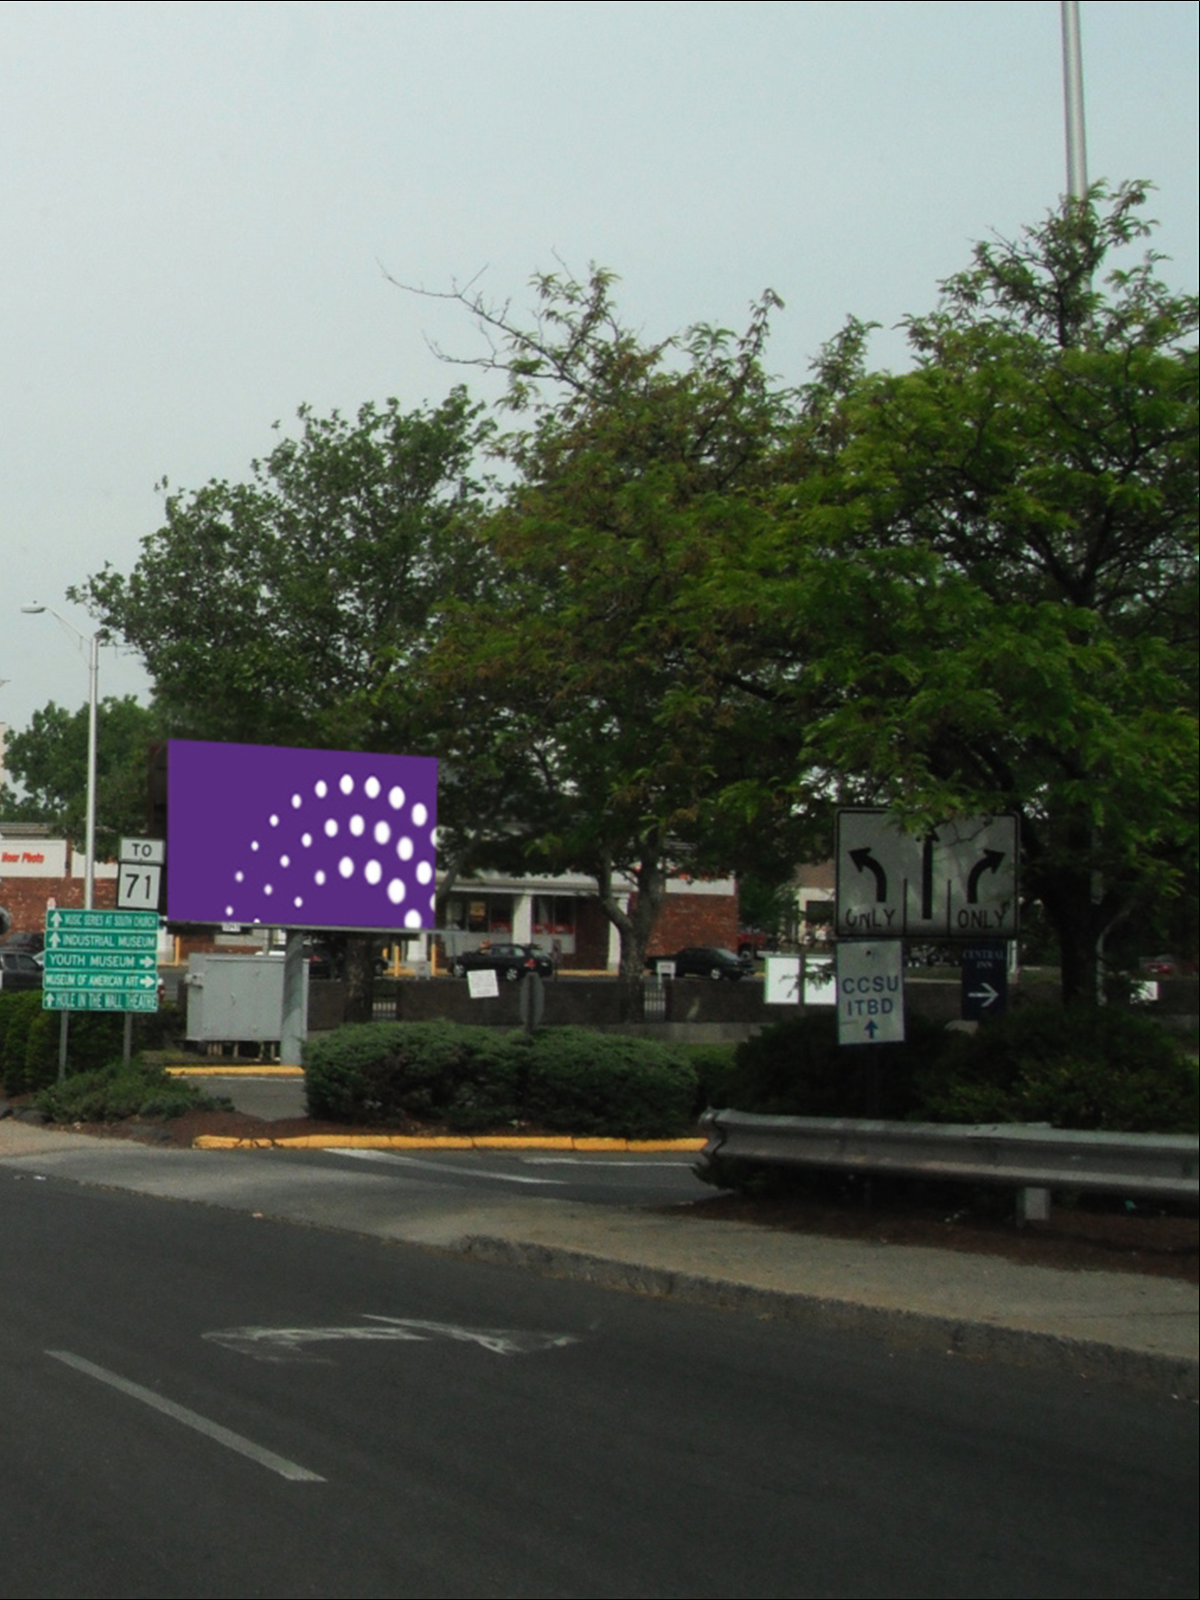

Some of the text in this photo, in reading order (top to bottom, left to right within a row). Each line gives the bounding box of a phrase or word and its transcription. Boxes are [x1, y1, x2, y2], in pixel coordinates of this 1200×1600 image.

[1, 852, 20, 863] Hour
[21, 852, 44, 863] Photo
[132, 843, 153, 858] TO
[126, 873, 151, 900] 71
[105, 915, 113, 927] AT
[114, 915, 132, 927] SOUTH
[133, 916, 156, 928] CHURCH
[845, 908, 896, 929] ONLY
[957, 909, 1007, 929] ONLY
[63, 934, 155, 948] INDUSTRIAL MUSEUM
[50, 954, 135, 967] YOUTH MUSEUM
[45, 974, 139, 987] MUSEUM OF AMERICAN ART
[842, 976, 899, 994] CCSU
[56, 993, 75, 1007] HOLE
[78, 993, 87, 1008] IN
[88, 993, 103, 1008] THE
[105, 994, 122, 1008] WALL
[847, 998, 894, 1016] ITBD
